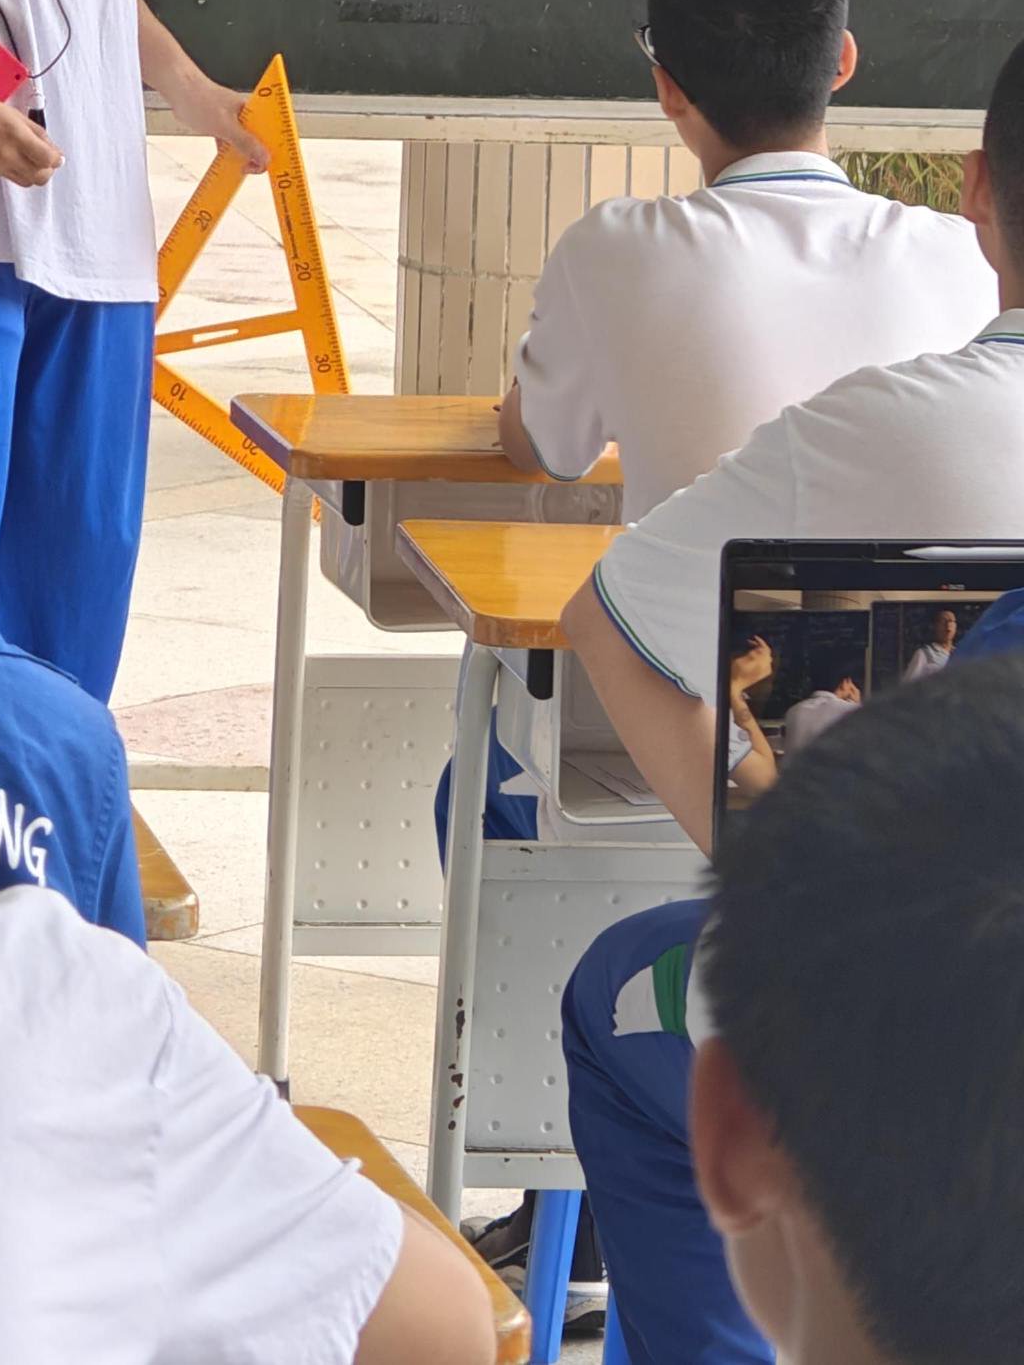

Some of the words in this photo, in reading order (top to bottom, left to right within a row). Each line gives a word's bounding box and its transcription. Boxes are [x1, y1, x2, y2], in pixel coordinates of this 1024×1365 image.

[276, 171, 292, 190] 10
[193, 209, 213, 231] 20
[294, 261, 312, 283] 20
[314, 354, 332, 374] 30
